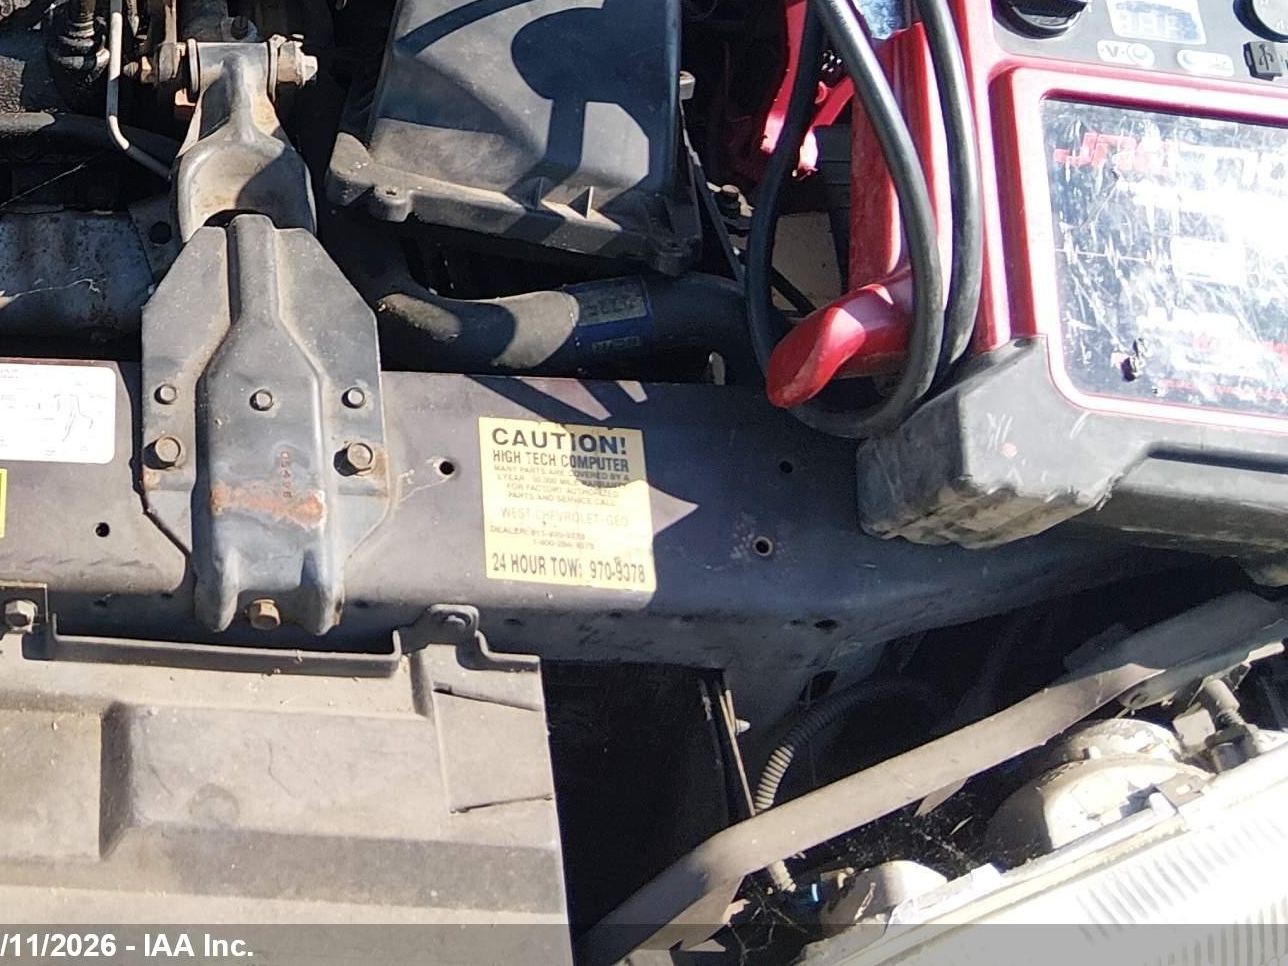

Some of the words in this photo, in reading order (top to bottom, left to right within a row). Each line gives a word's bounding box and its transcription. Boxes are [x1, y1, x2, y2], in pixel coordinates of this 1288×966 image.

[491, 427, 627, 456] CAUTION!
[492, 449, 522, 465] HIGH
[526, 451, 557, 469] TECH
[561, 453, 630, 473] COMPUTER
[569, 469, 608, 481] COVERED
[608, 472, 622, 481] BY
[623, 474, 631, 482] A
[500, 506, 531, 519] WEST
[492, 552, 507, 572] 24
[510, 553, 547, 576] HOUR
[550, 556, 584, 580] TOW:
